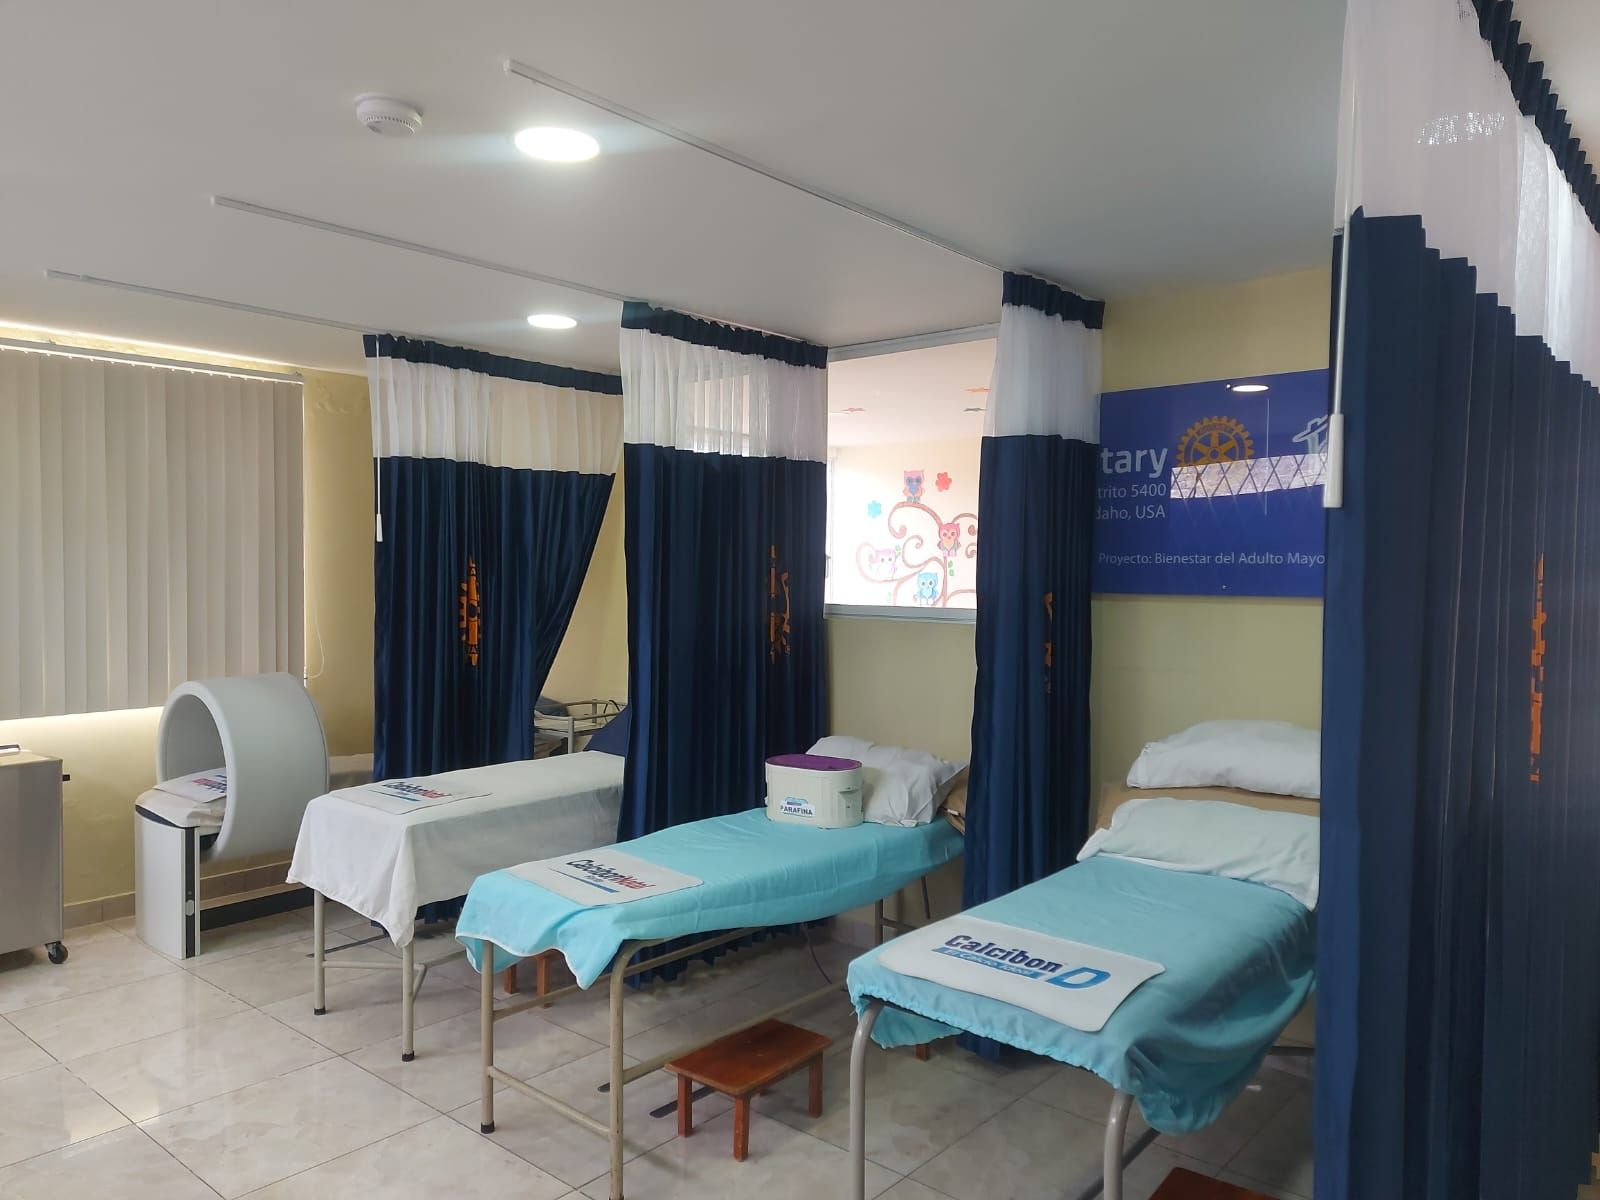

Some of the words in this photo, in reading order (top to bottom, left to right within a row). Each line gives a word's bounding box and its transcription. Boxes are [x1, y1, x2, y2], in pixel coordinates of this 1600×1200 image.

[1100, 447, 1168, 478] tary
[1097, 485, 1127, 499] trito
[1130, 483, 1167, 498] 5400
[1135, 504, 1166, 519] USA
[1098, 553, 1152, 566] Proyecto:
[1154, 552, 1211, 565] Bienestar
[1215, 552, 1235, 564] del
[1238, 552, 1283, 565] Adulto
[1287, 553, 1326, 568] Mayo
[944, 934, 1063, 973] Calcibon
[1045, 966, 1111, 989] D
